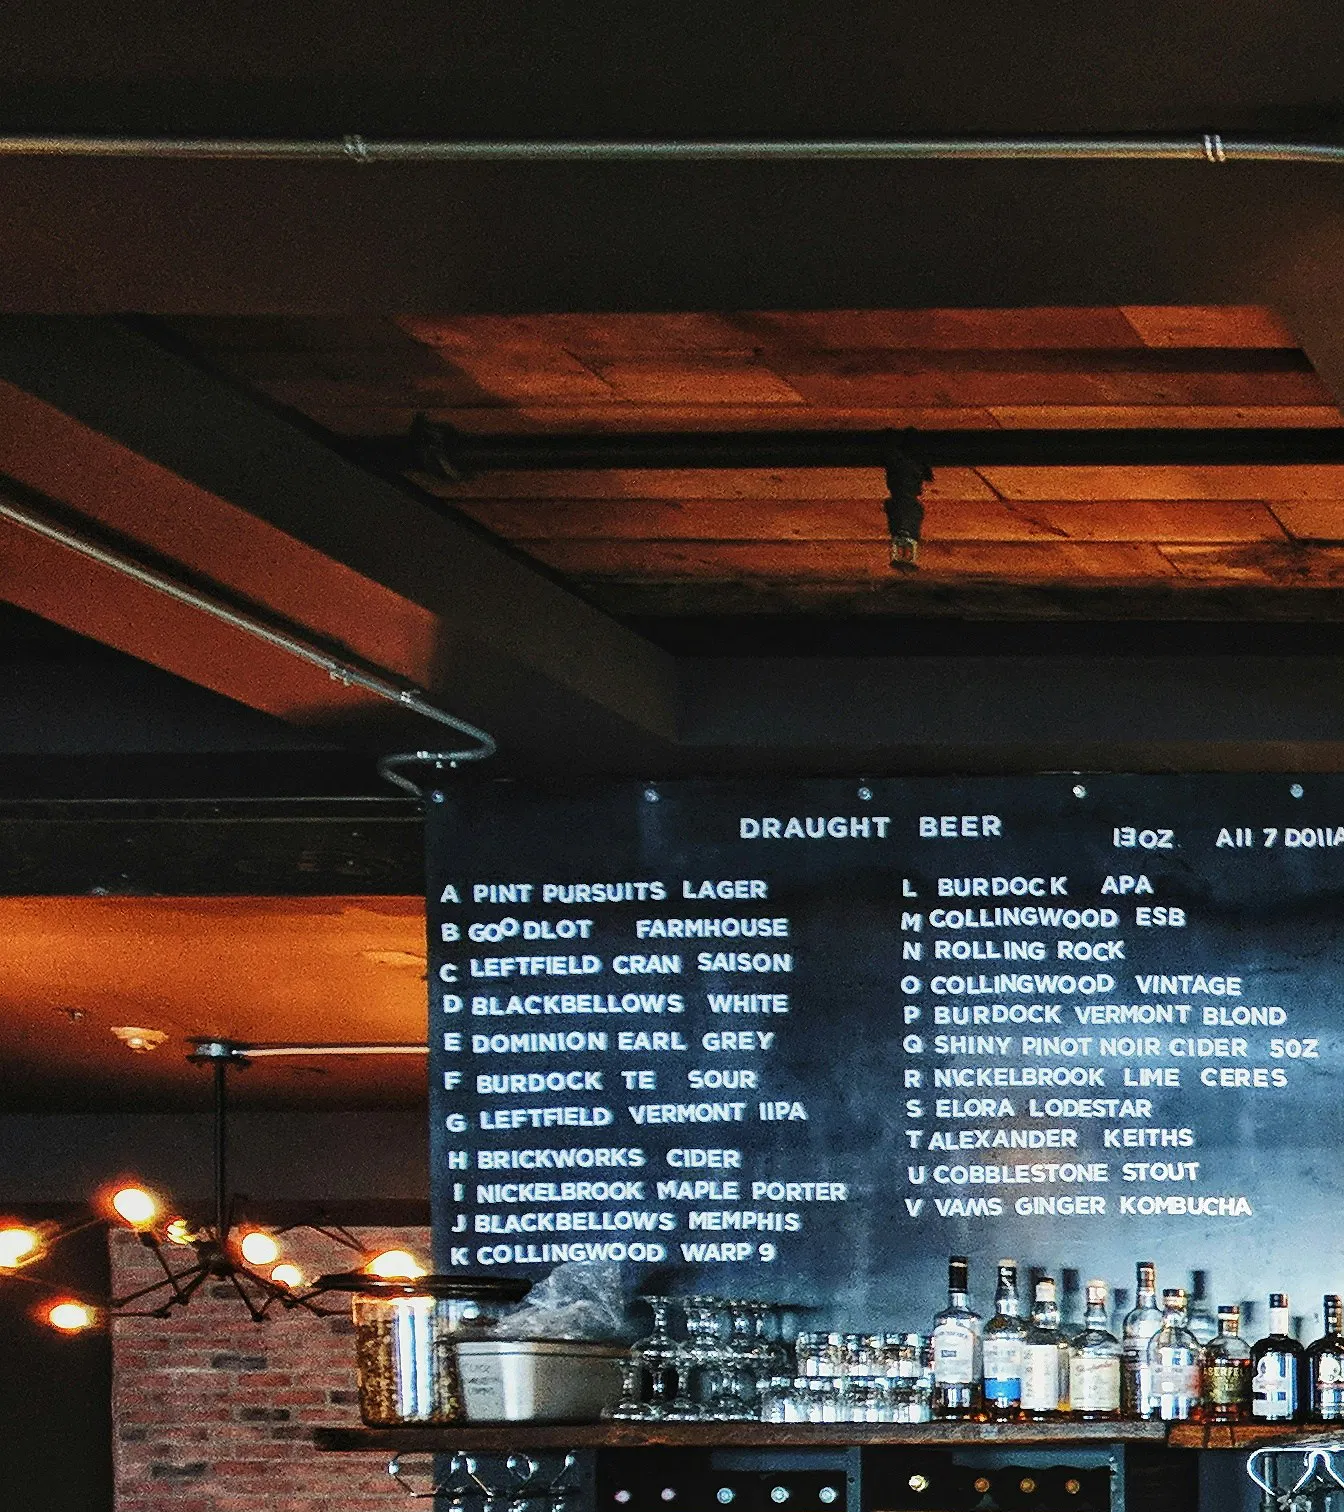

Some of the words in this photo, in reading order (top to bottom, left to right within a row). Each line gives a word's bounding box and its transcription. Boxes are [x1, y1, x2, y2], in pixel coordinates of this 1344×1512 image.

[740, 817, 890, 838] DRAUGHT
[920, 815, 1001, 837] BEER
[1263, 828, 1277, 847] 7
[441, 885, 459, 903] A
[474, 884, 532, 903] PINT
[543, 881, 666, 903] PURSUITS
[683, 880, 767, 899] LAGER
[903, 879, 917, 897] L
[938, 877, 1067, 897] BURDOCK
[1101, 875, 1153, 894] APA
[441, 923, 460, 942] B
[637, 918, 788, 938] FARMHOUSE
[901, 912, 922, 932] M
[929, 907, 1119, 929] COLLINGWOOD
[1136, 907, 1185, 926] ESB
[903, 941, 922, 960] N
[935, 941, 1046, 960] ROLLING
[1058, 941, 1125, 961] ROCK
[440, 963, 457, 982] C
[471, 955, 601, 977] LEFTFIELD
[613, 955, 680, 974] CRAN
[698, 953, 791, 972] SAISON
[901, 976, 921, 994] O
[931, 974, 1115, 994] COLLINGWOOD
[1136, 975, 1242, 996] VINTAGE
[443, 995, 463, 1013] D
[472, 994, 684, 1015] BLACKBELLOWS
[707, 994, 788, 1013] WHITE
[904, 1006, 920, 1024] P
[935, 1005, 1062, 1025] BURDOCK
[1075, 1005, 1191, 1024] VERMONT
[1203, 1006, 1287, 1026] BLOND
[444, 1033, 461, 1051] E
[472, 1032, 607, 1053] DOMINION
[618, 1032, 687, 1050] EARL
[702, 1031, 774, 1051] GREY
[903, 1035, 924, 1053] Q
[935, 1035, 1013, 1055] SHINY
[1023, 1037, 1093, 1057] PINOT
[1100, 1037, 1162, 1056] NOIR
[1166, 1038, 1248, 1057] CIDER
[444, 1071, 461, 1090] F
[477, 1071, 602, 1093] BURDOCK
[621, 1071, 655, 1089] TE
[688, 1070, 757, 1088] SOUR
[905, 1070, 922, 1088] R
[935, 1067, 1104, 1087] NICKELBROOK
[1124, 1068, 1179, 1086] LIME
[1201, 1068, 1287, 1087] CERES
[446, 1113, 466, 1132] G
[480, 1107, 612, 1129] LEFTFIELD
[629, 1102, 746, 1124] VERMONT
[906, 1099, 923, 1117] S
[936, 1098, 1015, 1117] ELORA
[1030, 1099, 1152, 1117] LODESTAR
[906, 1130, 923, 1148] T
[929, 1129, 1077, 1150] ALEXANDER
[1104, 1128, 1194, 1147] KEITHS
[449, 1151, 467, 1169] H
[478, 1148, 645, 1169] BRICKWORKS
[667, 1149, 740, 1168] CIDER
[908, 1166, 926, 1184] U
[934, 1163, 1108, 1184] COBBLESTONE
[1123, 1162, 1199, 1181] STOUT
[477, 1182, 644, 1203] NICKELBROOK
[657, 1180, 739, 1200] MAPLE
[752, 1182, 847, 1201] PORTER
[905, 1199, 924, 1217] V
[934, 1198, 1004, 1216] VAMS
[1015, 1196, 1106, 1215] GINGER
[1120, 1196, 1252, 1216] KOMBUCHA
[452, 1214, 466, 1232] J
[475, 1211, 676, 1233] BLACKBELLOWS
[689, 1211, 800, 1231] MEMPHIS
[451, 1247, 469, 1265] K
[477, 1242, 666, 1268] COLLINGWOOD
[681, 1243, 753, 1261] WARP
[759, 1243, 775, 1261] 9
